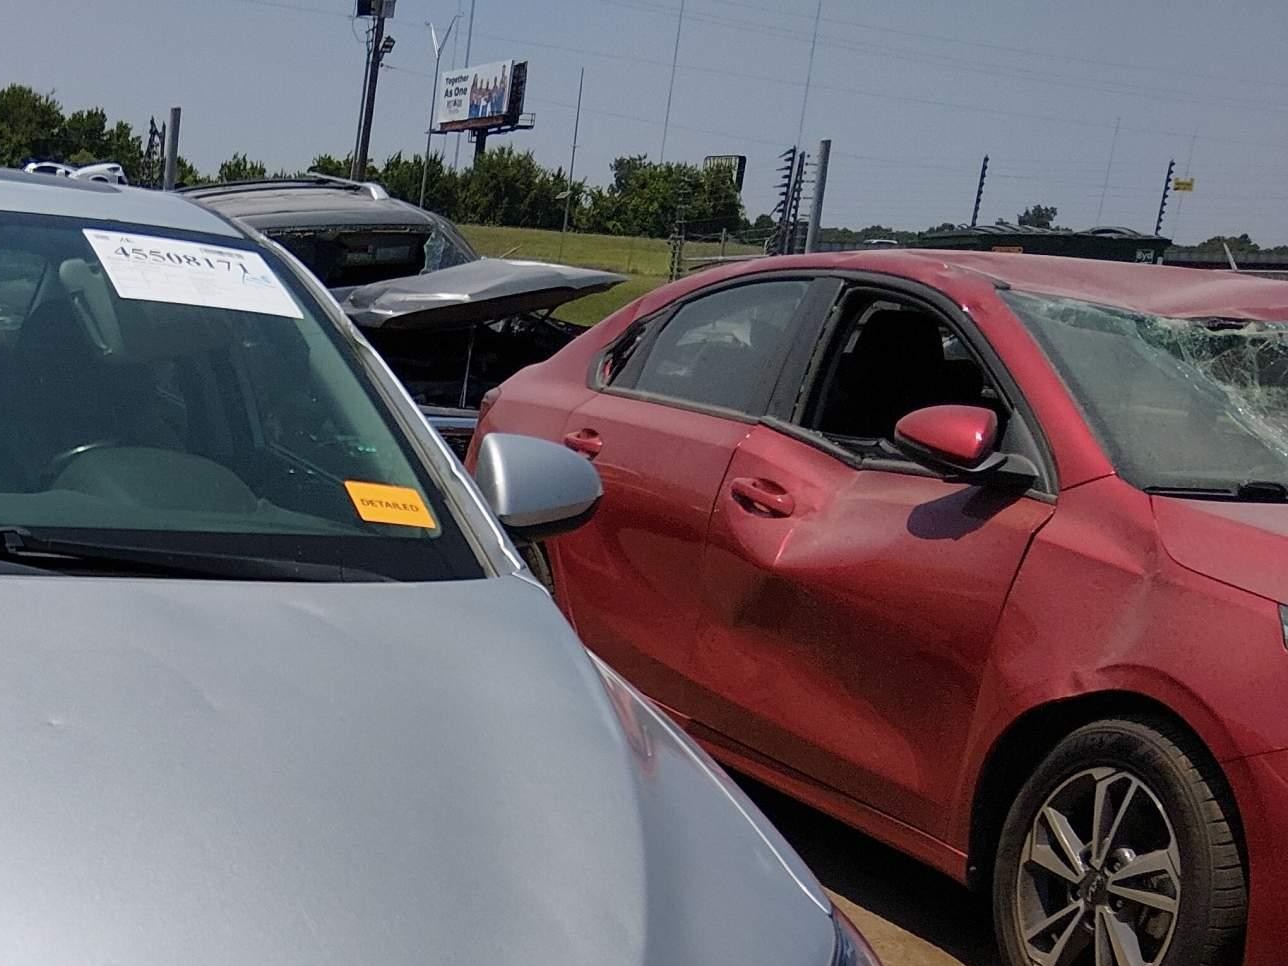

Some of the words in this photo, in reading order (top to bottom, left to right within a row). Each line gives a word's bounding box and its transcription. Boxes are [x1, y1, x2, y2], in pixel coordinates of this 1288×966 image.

[445, 75, 469, 86] Together
[444, 88, 453, 98] As
[454, 87, 468, 96] One
[114, 246, 250, 275] 45508171
[360, 498, 420, 512] DETAILED
